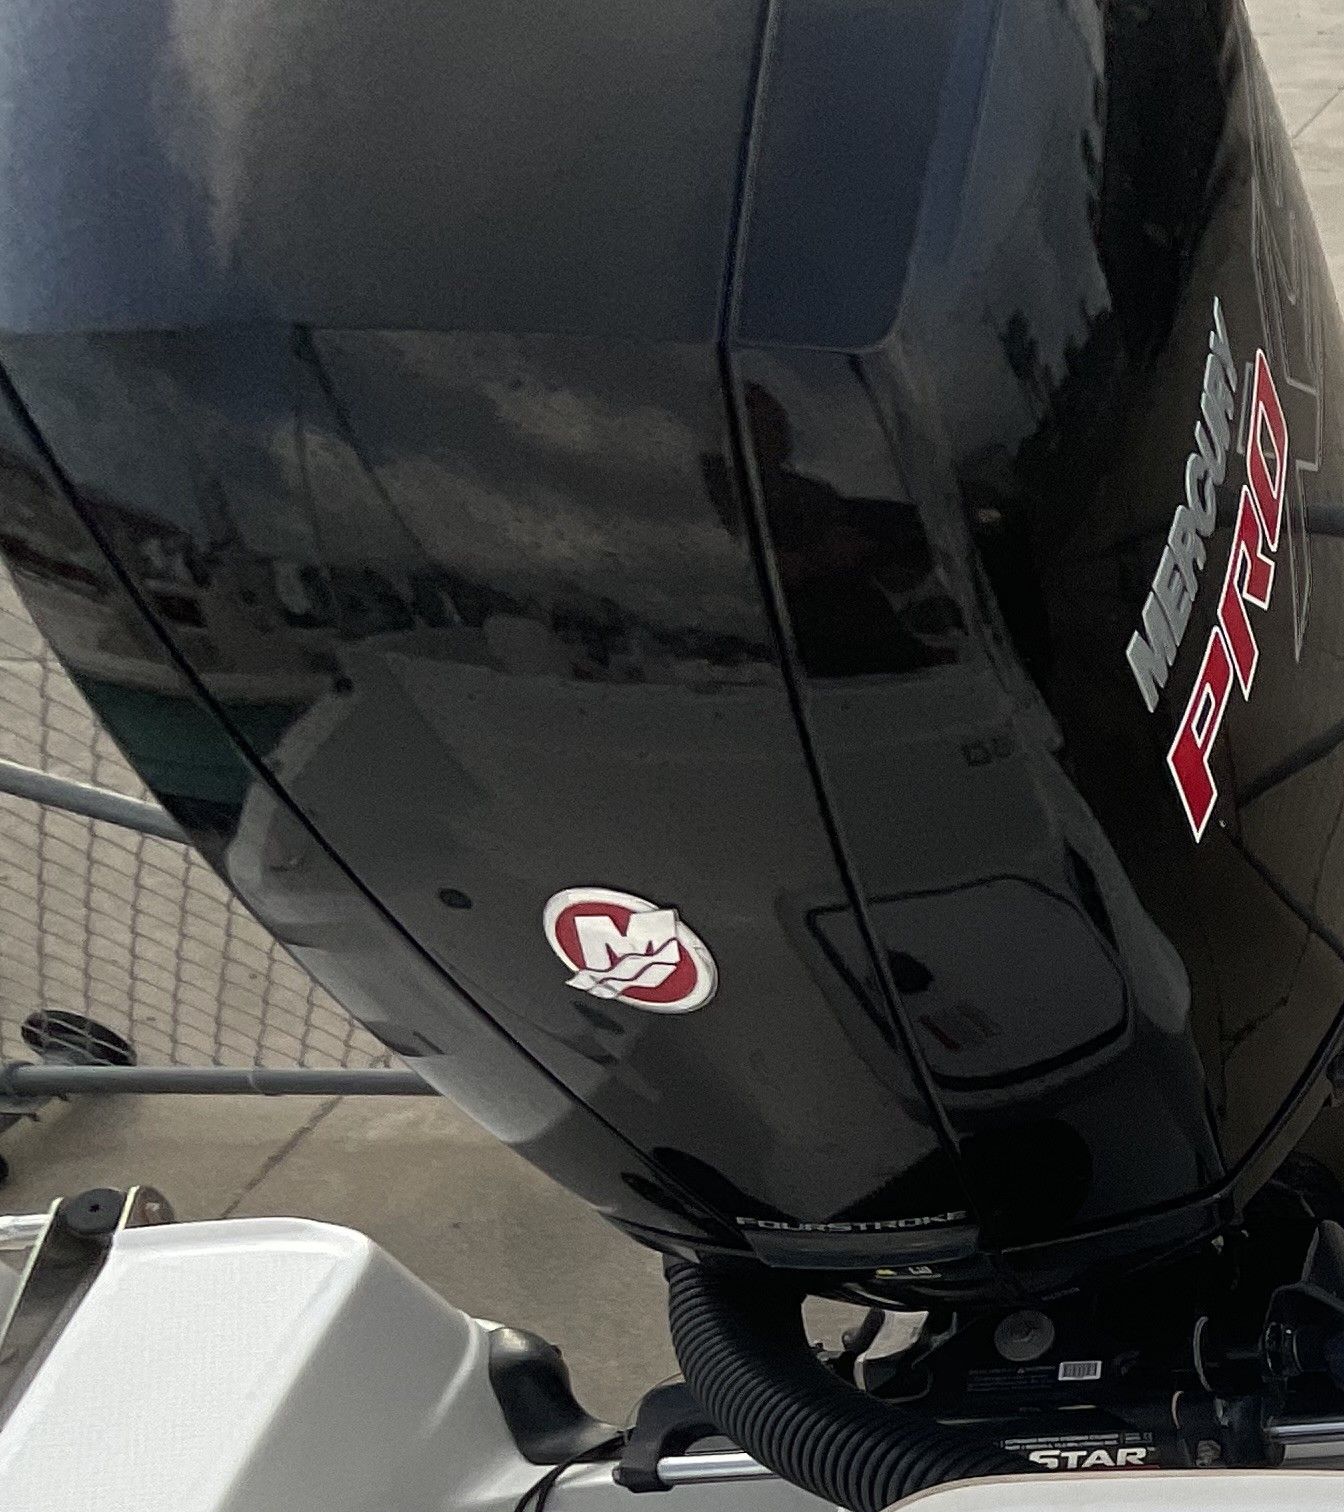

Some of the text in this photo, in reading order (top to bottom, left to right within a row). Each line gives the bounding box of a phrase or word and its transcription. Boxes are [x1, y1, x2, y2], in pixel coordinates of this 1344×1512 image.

[1126, 297, 1238, 713] MERCURY
[1168, 349, 1288, 843] PRO
[736, 1211, 967, 1232] FOURSTROKE
